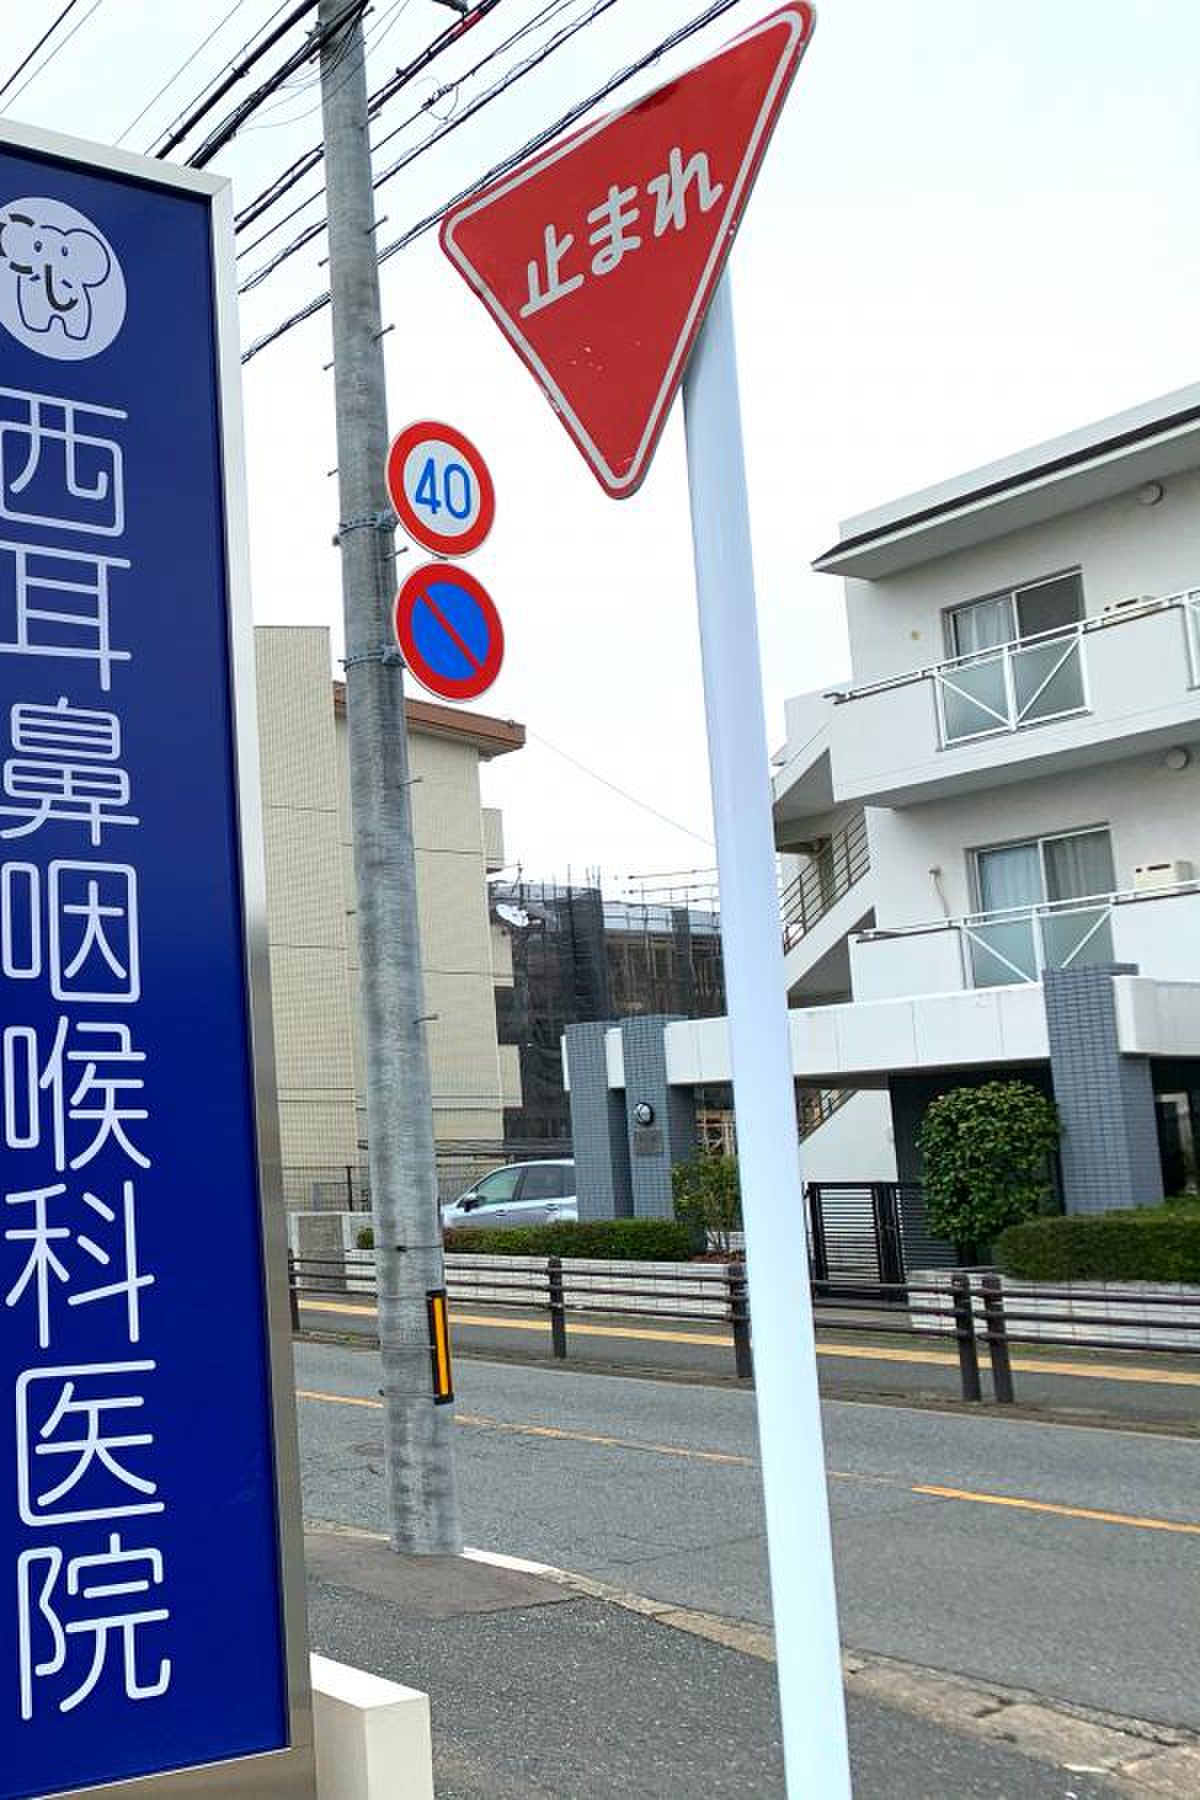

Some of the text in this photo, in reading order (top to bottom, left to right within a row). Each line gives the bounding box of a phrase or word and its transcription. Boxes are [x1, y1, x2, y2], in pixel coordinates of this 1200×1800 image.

[519, 146, 723, 319] 止まれ
[413, 456, 473, 522] 40
